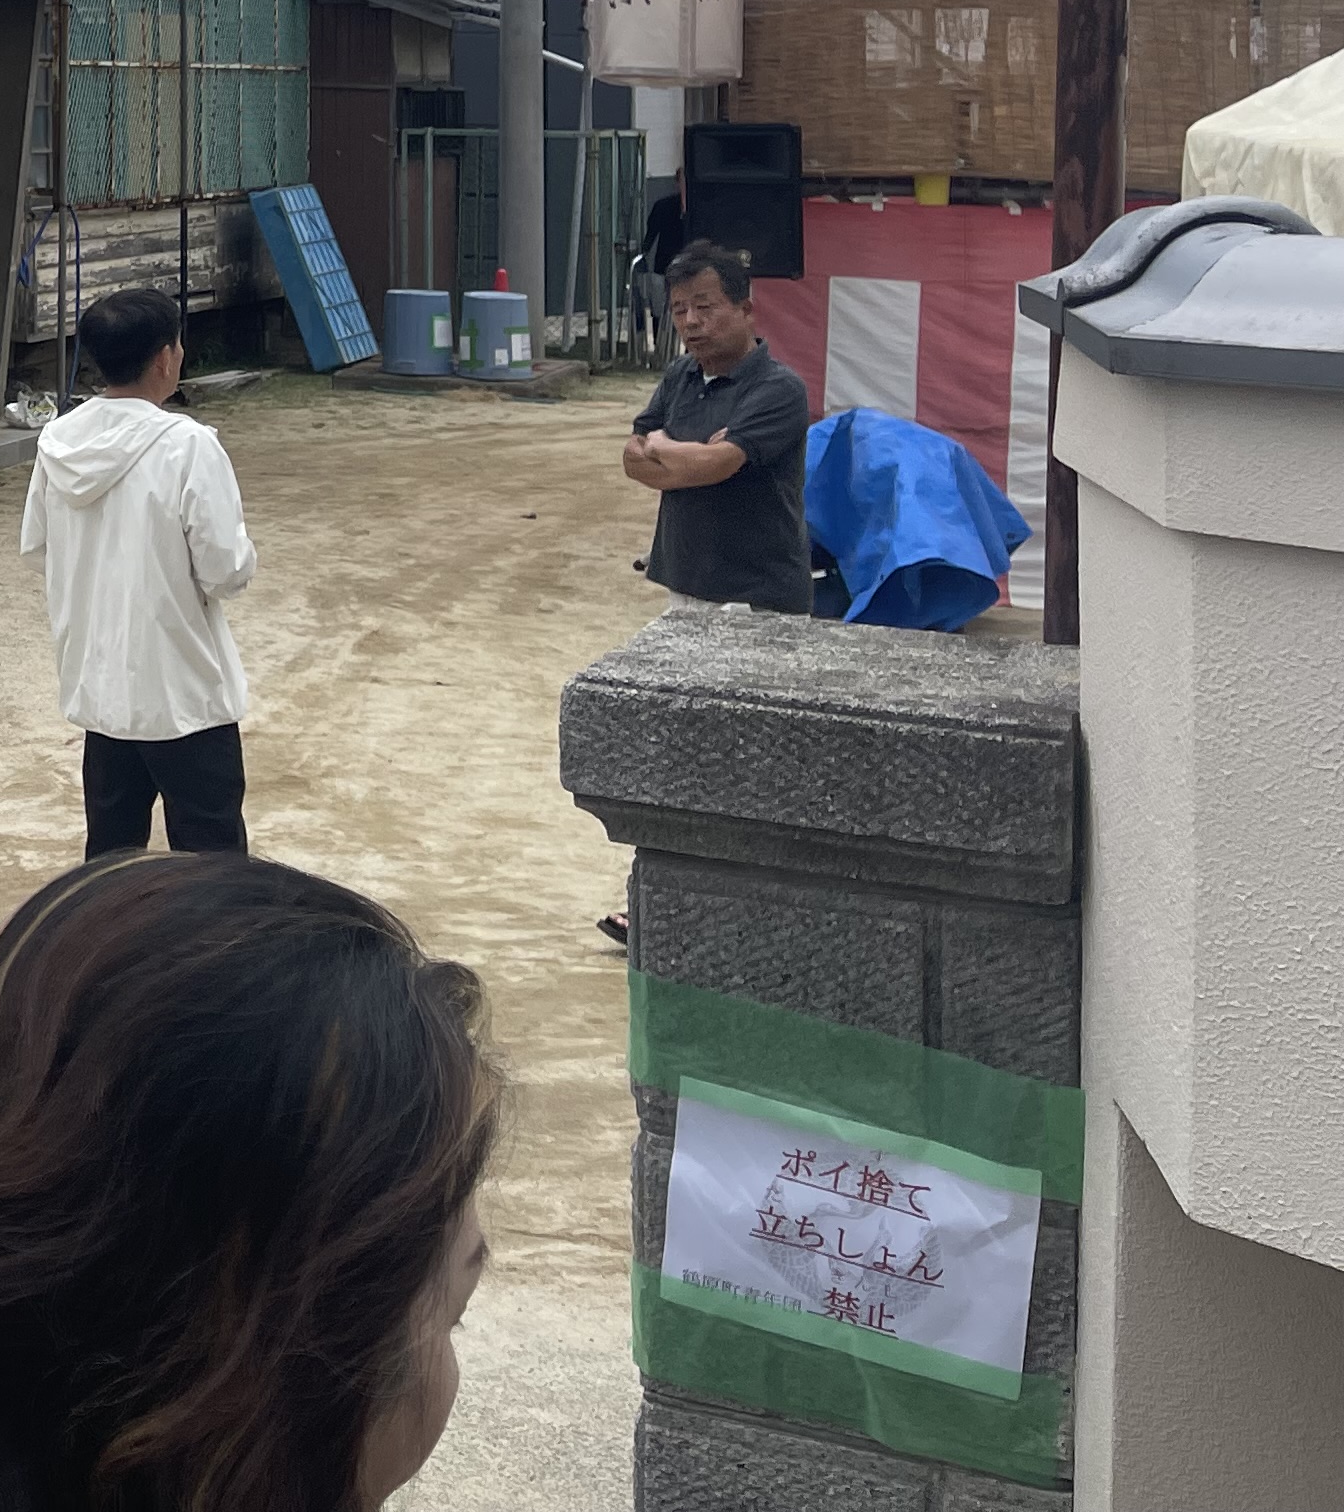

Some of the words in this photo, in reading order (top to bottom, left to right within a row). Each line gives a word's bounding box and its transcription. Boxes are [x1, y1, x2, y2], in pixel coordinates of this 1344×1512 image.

[781, 1148, 931, 1214] ポイ捨て
[752, 1206, 944, 1281] 立ちしょん
[824, 1287, 897, 1334] 禁止
